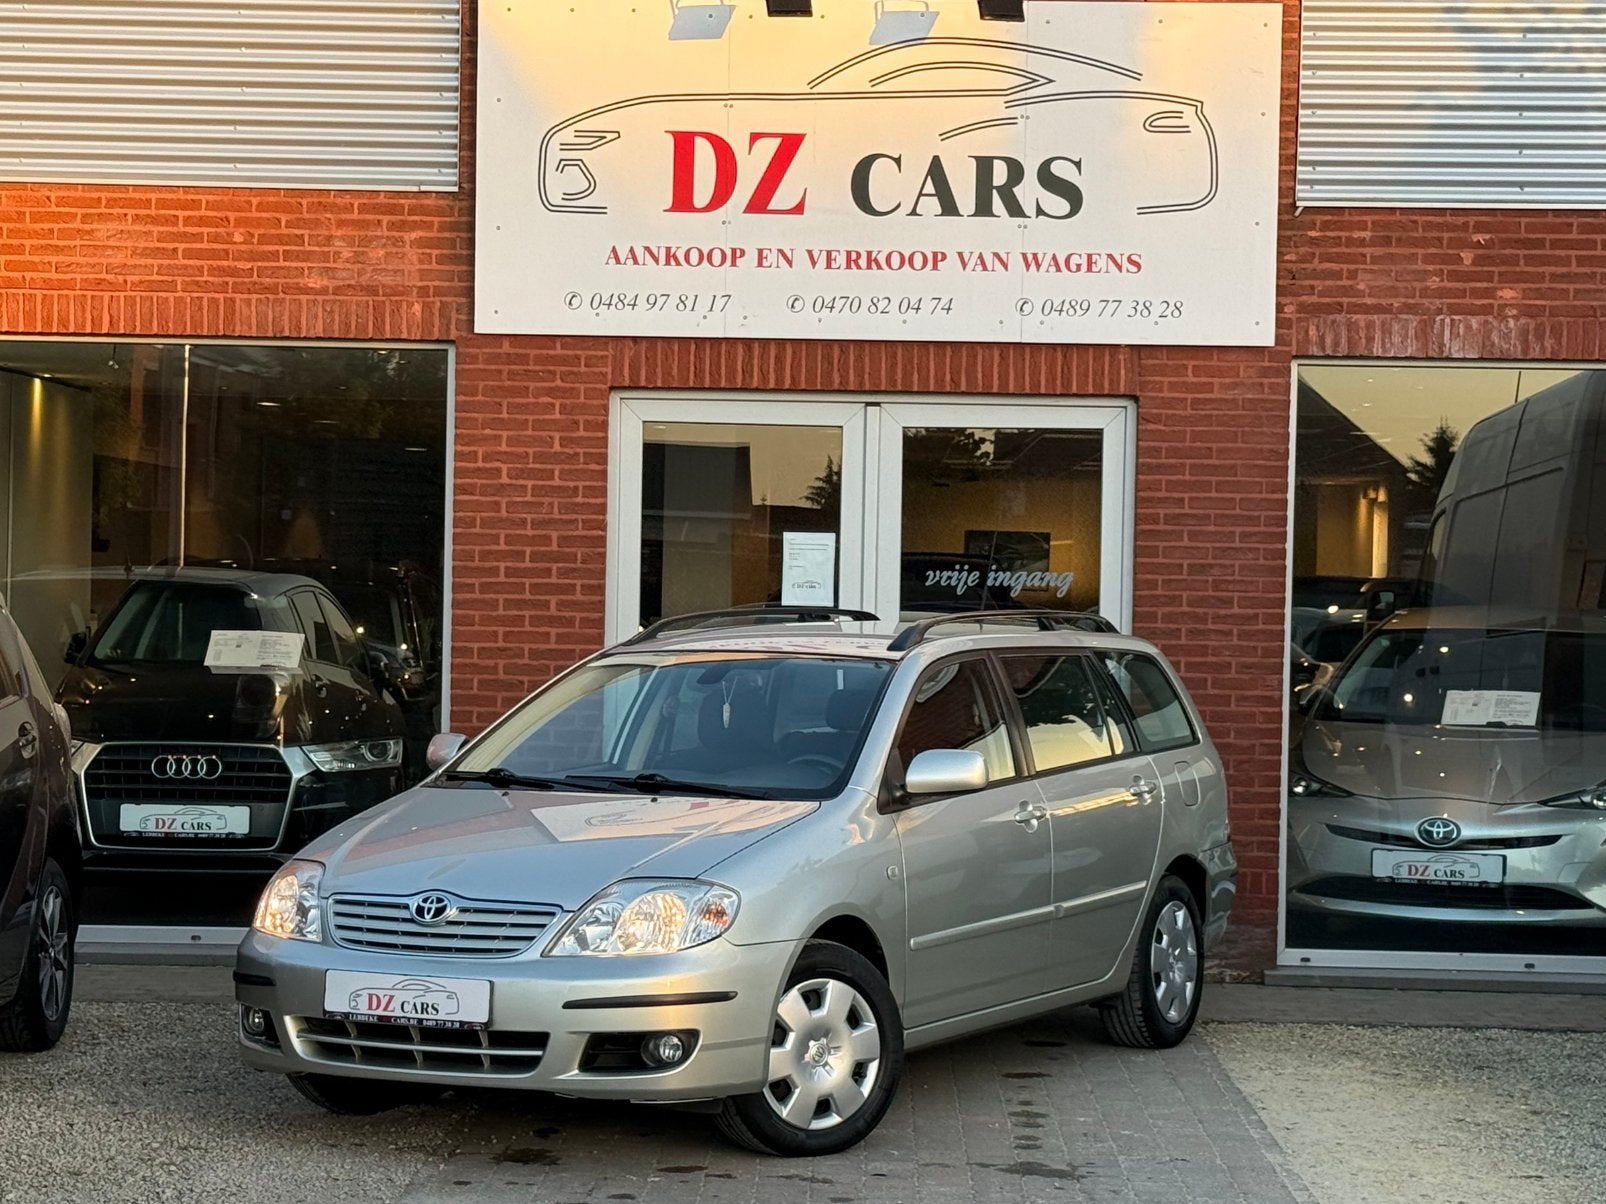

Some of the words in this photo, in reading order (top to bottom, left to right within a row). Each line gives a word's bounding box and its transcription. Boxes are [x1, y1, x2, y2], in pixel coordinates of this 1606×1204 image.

[664, 131, 808, 215] DZ
[850, 153, 1083, 219] CARS
[606, 246, 745, 268] AANKOOP
[756, 248, 796, 269] EN
[806, 249, 947, 272] VERKOOP
[956, 252, 1011, 273] VAN
[1021, 252, 1142, 274] WAGENS
[590, 293, 639, 311] 0484
[646, 294, 671, 312] 97
[676, 294, 699, 312] 81
[707, 295, 732, 313] 17
[812, 295, 862, 314] 0470
[867, 296, 892, 315] 82
[898, 297, 924, 315] 04
[930, 297, 954, 315] 74
[1041, 298, 1091, 317] 0489
[1098, 299, 1124, 318] 77
[1128, 300, 1153, 319] 38
[1158, 300, 1184, 319] 28
[925, 564, 980, 596] vrije
[987, 565, 1074, 599] ingang
[154, 817, 178, 831] DZ
[181, 821, 212, 832] CARS
[1406, 863, 1430, 877] DZ
[1434, 868, 1465, 879] CARS
[367, 992, 396, 1013] DZ
[400, 1000, 440, 1016] CARS
